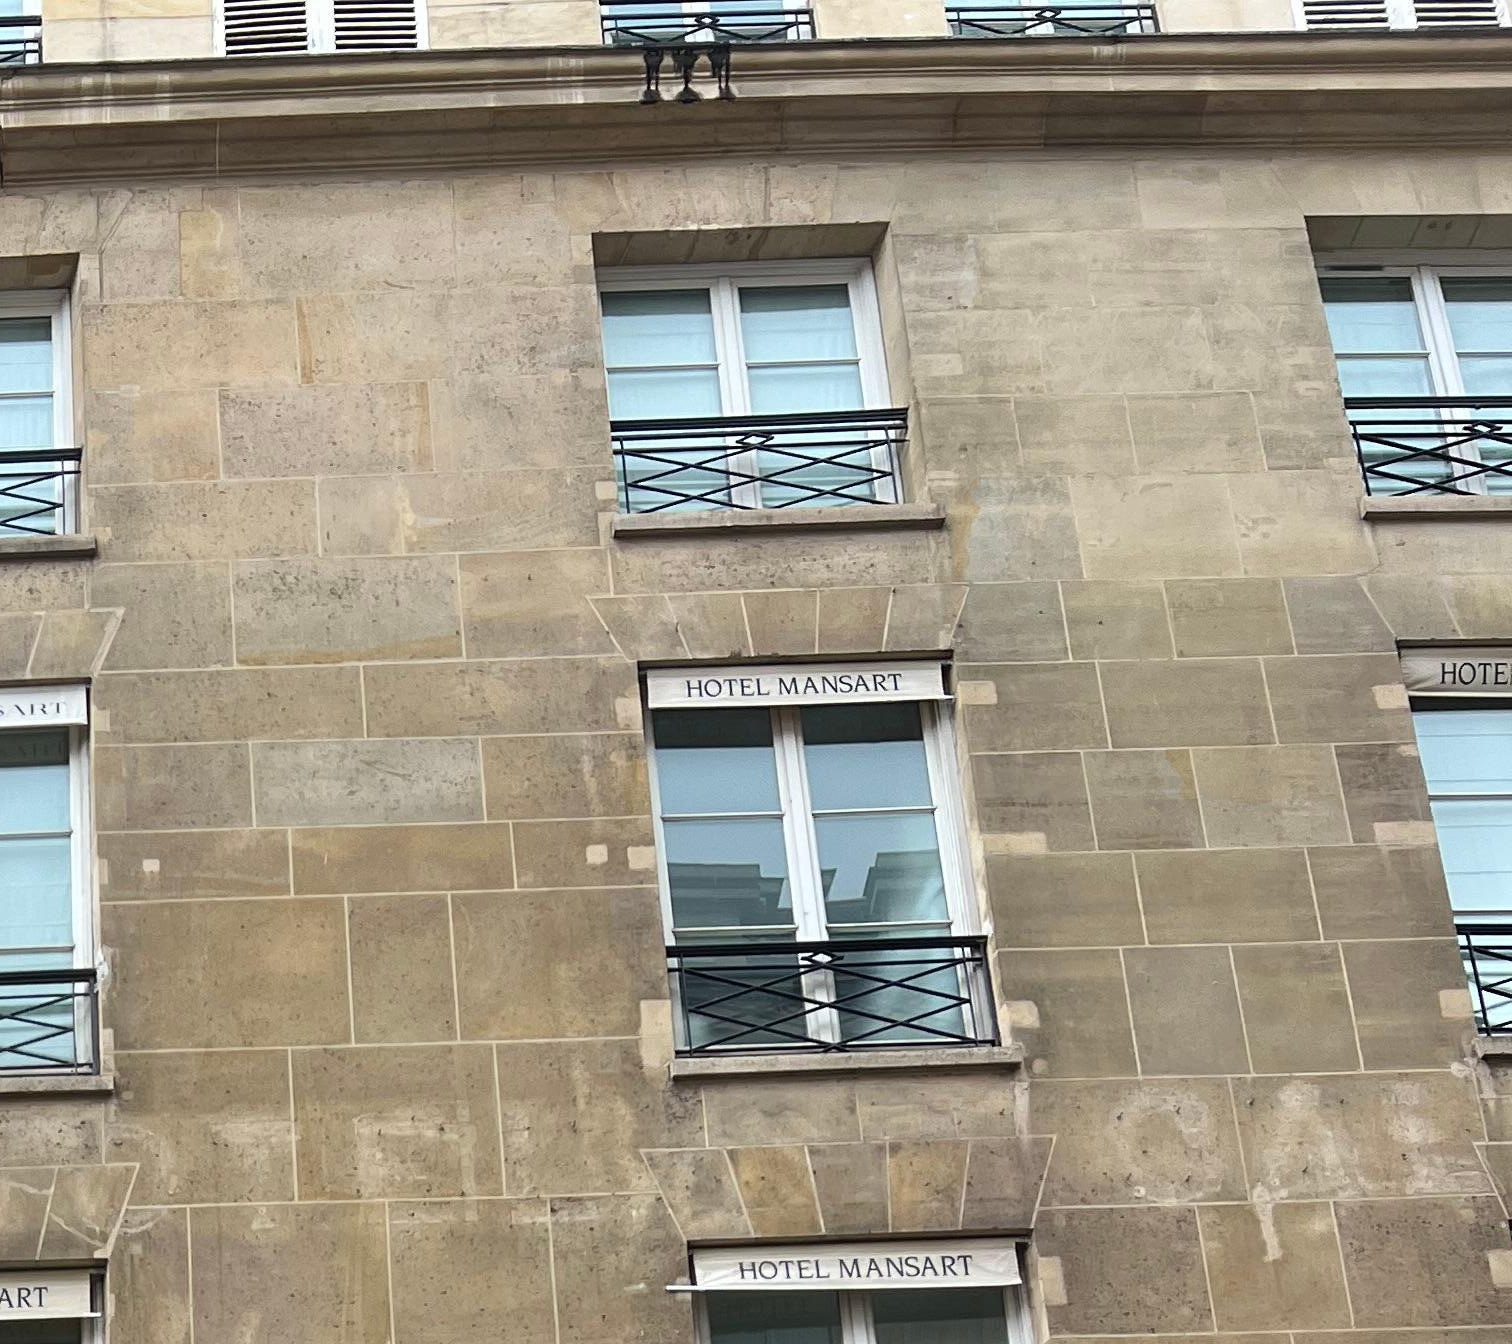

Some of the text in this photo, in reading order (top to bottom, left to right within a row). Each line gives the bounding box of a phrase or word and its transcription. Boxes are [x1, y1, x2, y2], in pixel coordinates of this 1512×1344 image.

[686, 672, 904, 699] HOTEL MANSART
[1439, 661, 1512, 686] HOTE
[738, 1253, 974, 1281] HOTEL MANSART
